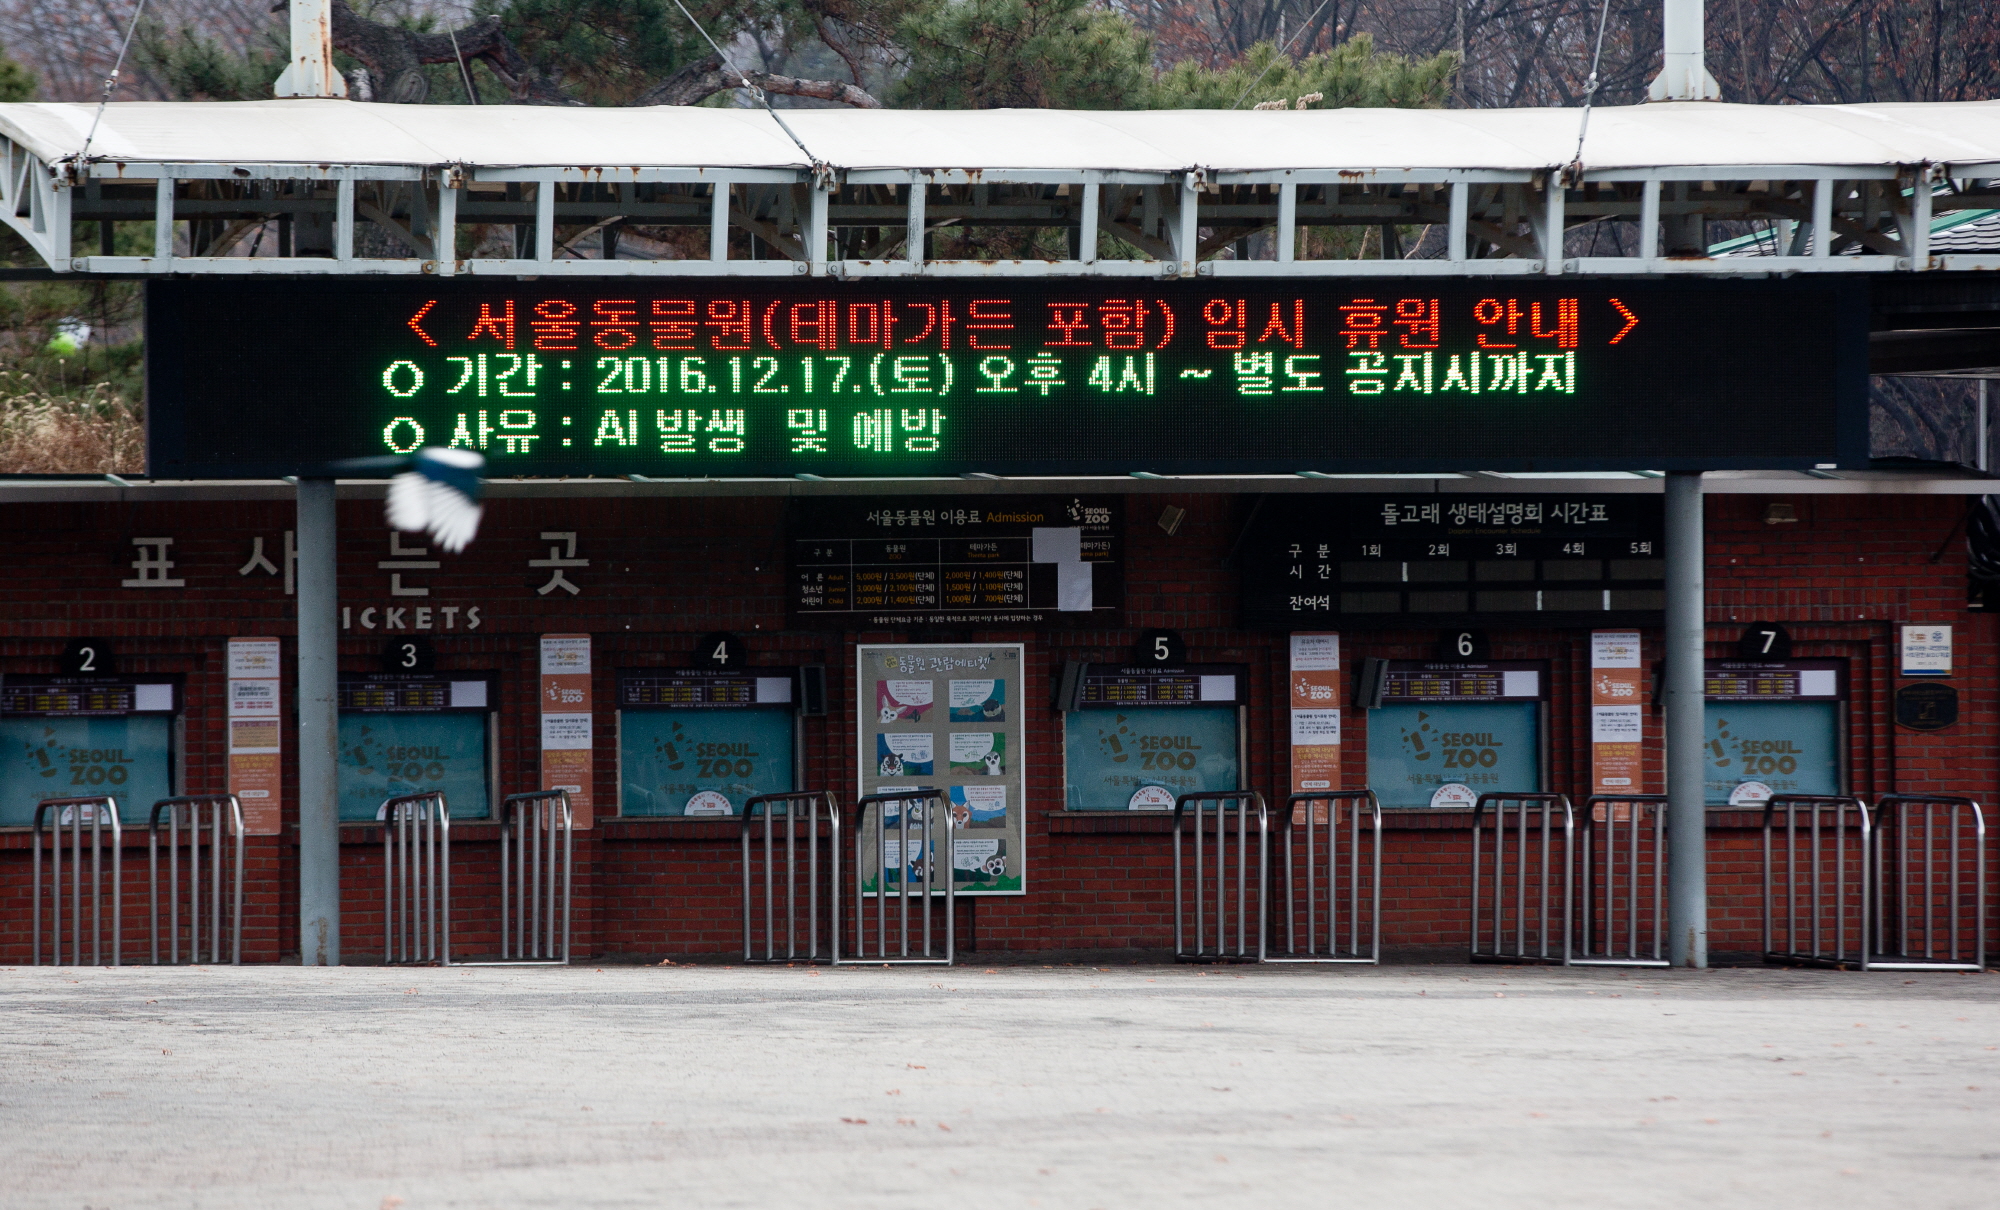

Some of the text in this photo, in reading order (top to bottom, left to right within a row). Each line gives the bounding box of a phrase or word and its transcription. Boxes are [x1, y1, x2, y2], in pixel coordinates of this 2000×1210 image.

[1043, 299, 1174, 350] 포함)
[1203, 298, 1304, 349] 임시
[1338, 298, 1440, 349] 휴원
[1473, 298, 1579, 349] 안내
[446, 353, 542, 397] 기간
[596, 352, 955, 396] 2016.12.17.(토)
[975, 352, 1066, 396] 오후
[1088, 352, 1154, 395] 4시
[1233, 351, 1324, 395] 별도
[1345, 351, 1576, 395] 공지시까지
[447, 409, 540, 454] 사유
[593, 408, 638, 446] AI
[656, 408, 745, 453] 발생
[787, 408, 827, 453] 및
[853, 408, 947, 453] 예방
[866, 508, 1044, 526] 서울동물원 이용료 Admission
[1084, 507, 1112, 515] SEOUL
[1084, 514, 1110, 524] ZOO
[1380, 501, 1609, 526] 돌고래 생태설명회 시간표
[885, 544, 907, 554] 동물원
[969, 542, 998, 552] 테마가든
[1361, 543, 1382, 558] 1회
[1428, 542, 1450, 557] 2회
[1496, 541, 1517, 556] 3회
[1562, 540, 1585, 556] 4회
[1630, 540, 1652, 556] 5회
[121, 537, 186, 588] 표
[377, 530, 441, 597] 는
[528, 530, 590, 597] 곳
[1289, 595, 1331, 612] 잔여석
[342, 605, 482, 630] ICKETS
[1154, 636, 1169, 660] 5
[1457, 632, 1473, 656] 6
[1760, 631, 1776, 654] 7
[79, 647, 96, 672] 2
[401, 643, 417, 668] 3
[712, 640, 729, 665] 4
[899, 654, 926, 674] 동물원
[929, 655, 991, 673] 관람에티켓
[1310, 691, 1332, 700] ZOO
[1611, 688, 1634, 697] ZOO
[1140, 735, 1202, 750] SEOUL
[1441, 732, 1503, 747] SEOUL
[1741, 739, 1802, 754] SEOUL
[69, 749, 134, 764] SEOUL
[386, 746, 450, 762] SEOUL
[696, 742, 760, 757] SEOUL
[1443, 749, 1498, 768] ZOO
[697, 759, 754, 779] ZOO
[1140, 752, 1197, 771] ZOO
[1742, 756, 1798, 775] ZOO
[69, 765, 129, 785] ZOO
[387, 762, 445, 783] ZOO
